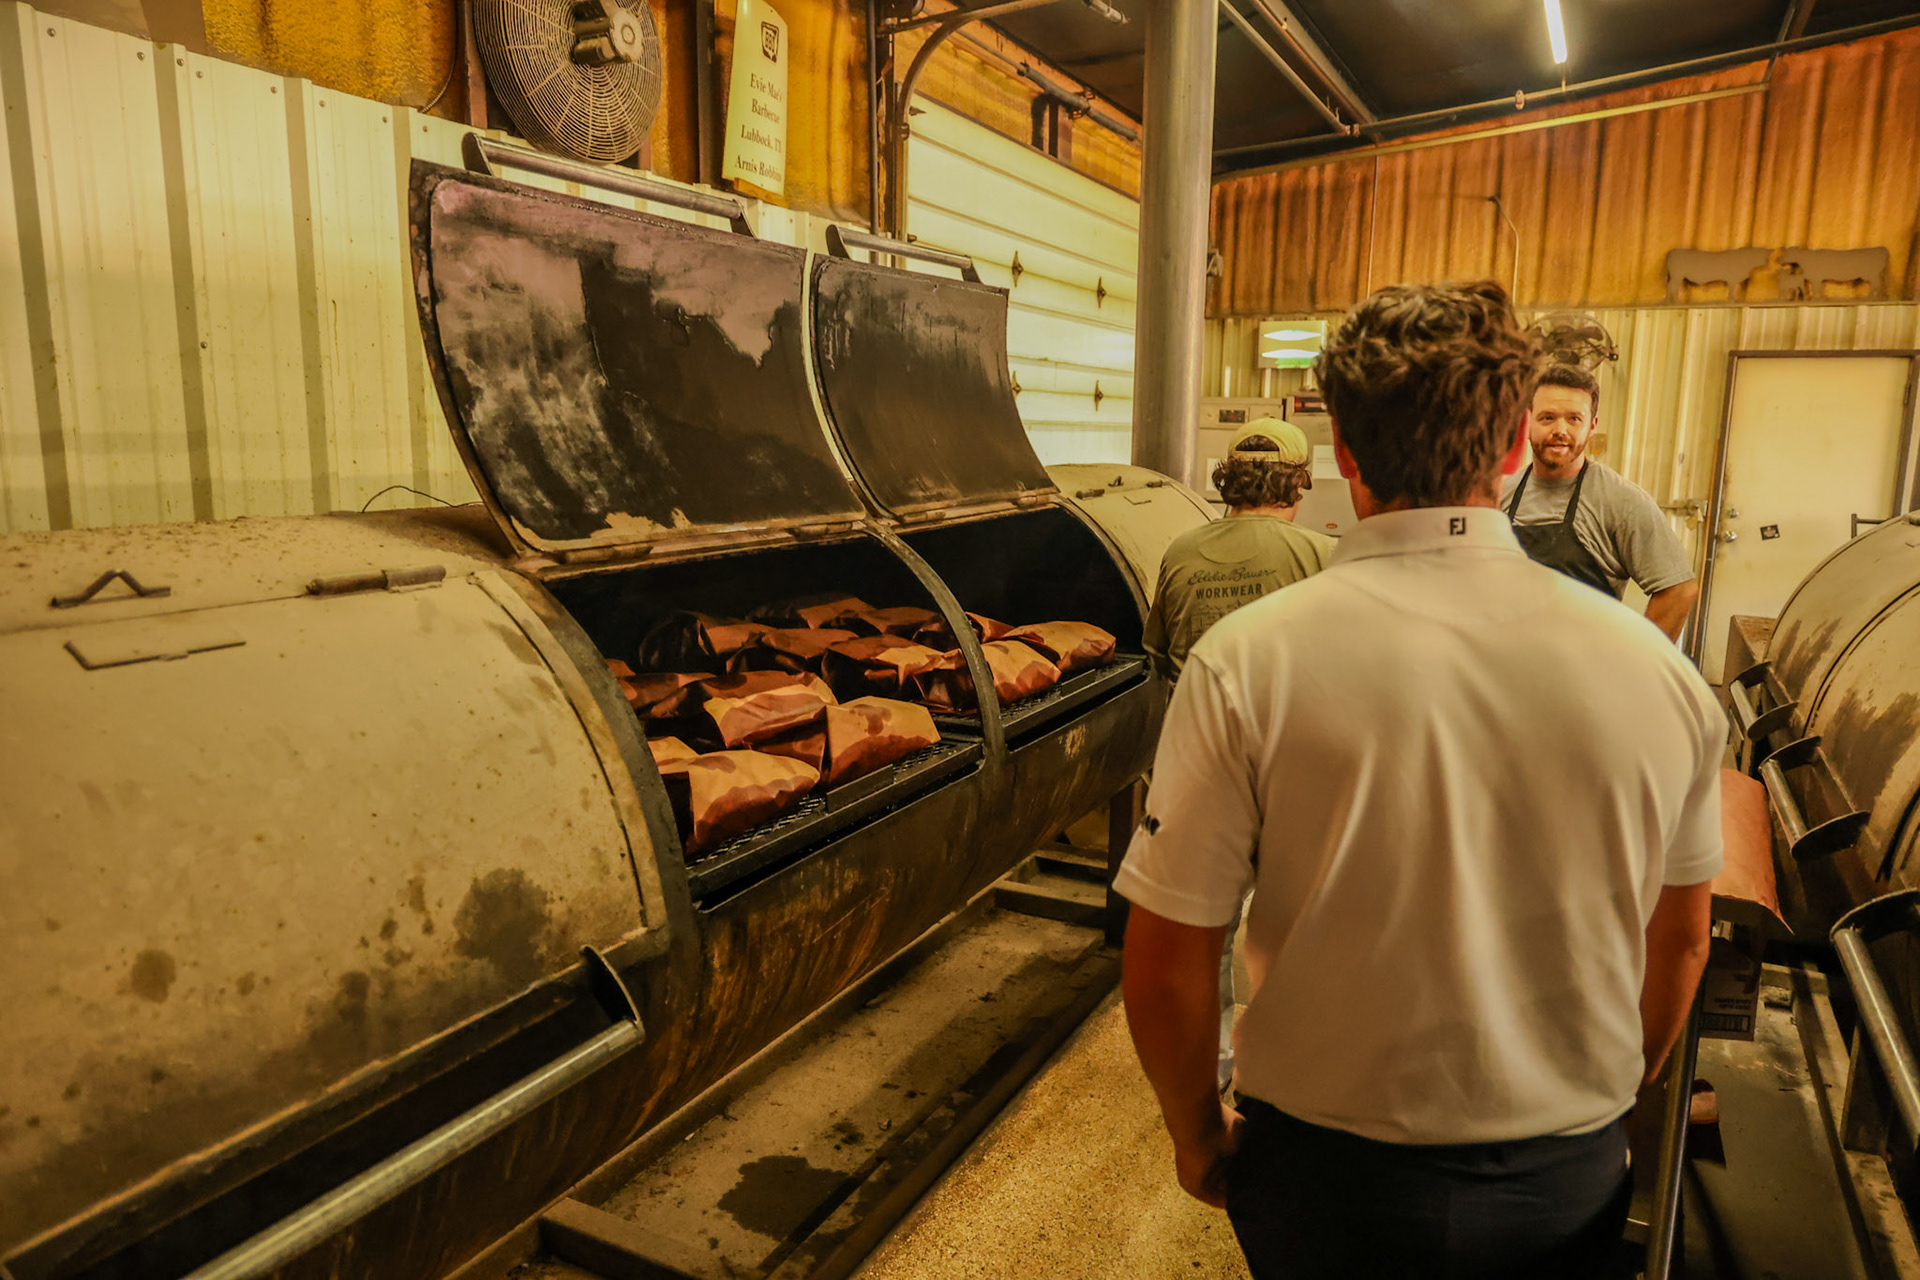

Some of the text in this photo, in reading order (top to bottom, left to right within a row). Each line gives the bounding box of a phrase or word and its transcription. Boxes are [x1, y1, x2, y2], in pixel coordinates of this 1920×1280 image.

[750, 73, 766, 92] Evie
[751, 98, 780, 125] Barbecue
[741, 124, 773, 150] Lubbock,
[735, 154, 757, 174] Arnis
[1449, 516, 1466, 536] FJ
[1187, 566, 1277, 586] Eddie Bauer
[1195, 583, 1263, 600] WORKWEAR
